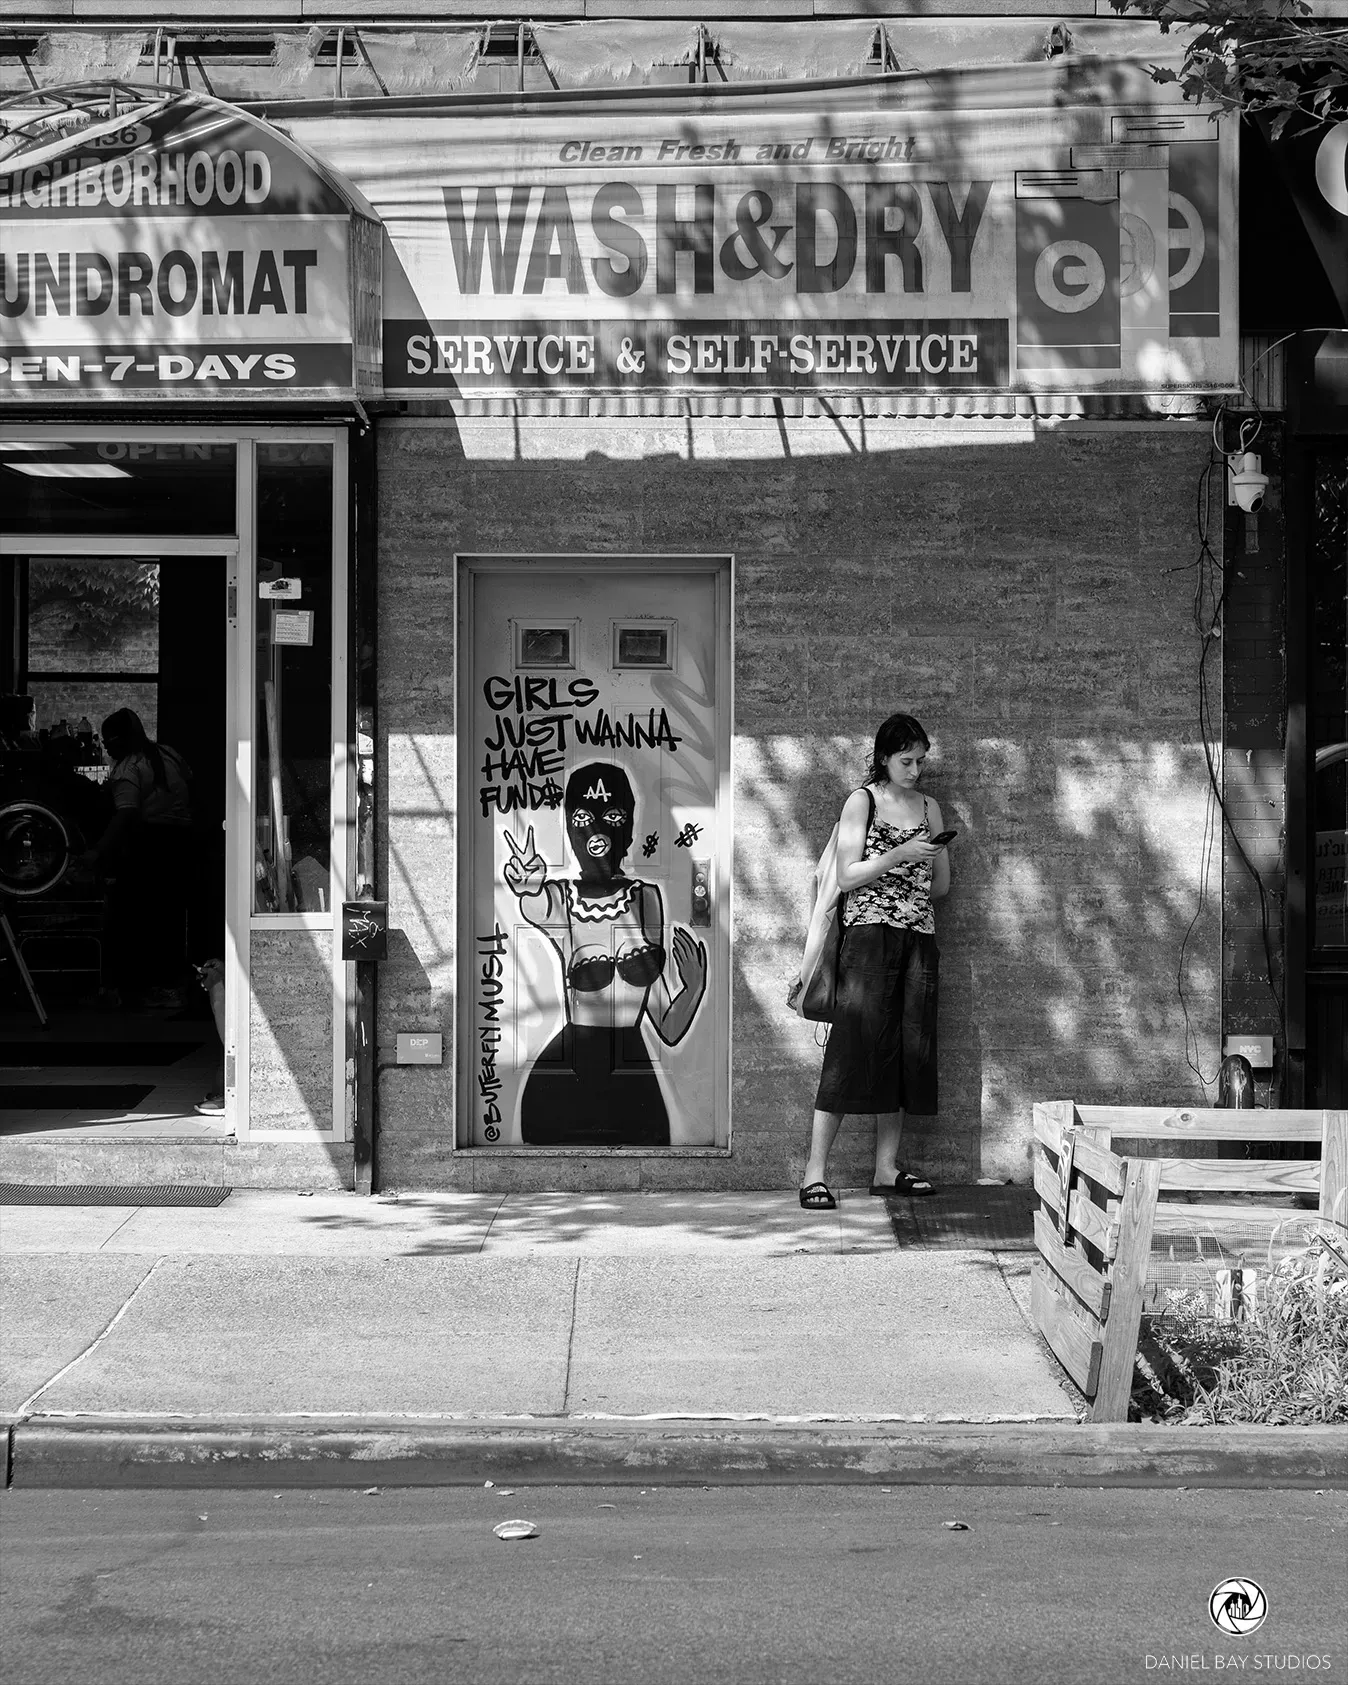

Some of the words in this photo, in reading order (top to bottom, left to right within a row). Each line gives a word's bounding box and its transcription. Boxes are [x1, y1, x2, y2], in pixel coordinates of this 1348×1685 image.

[559, 140, 643, 162] Clean
[657, 138, 742, 161] Fresh
[756, 137, 814, 160] and
[824, 135, 915, 163] Bright
[0, 249, 318, 318] UNDROMAT
[0, 353, 297, 381] EN-7-DAYS
[405, 335, 595, 375] SERVICE
[617, 336, 645, 374] &
[667, 334, 979, 375] SELF-SERVICE
[483, 675, 599, 714] GIRLS
[484, 714, 573, 751] JUST
[575, 708, 682, 751] WANNA
[481, 747, 565, 782] HAVE
[1239, 1044, 1262, 1054] NYC
